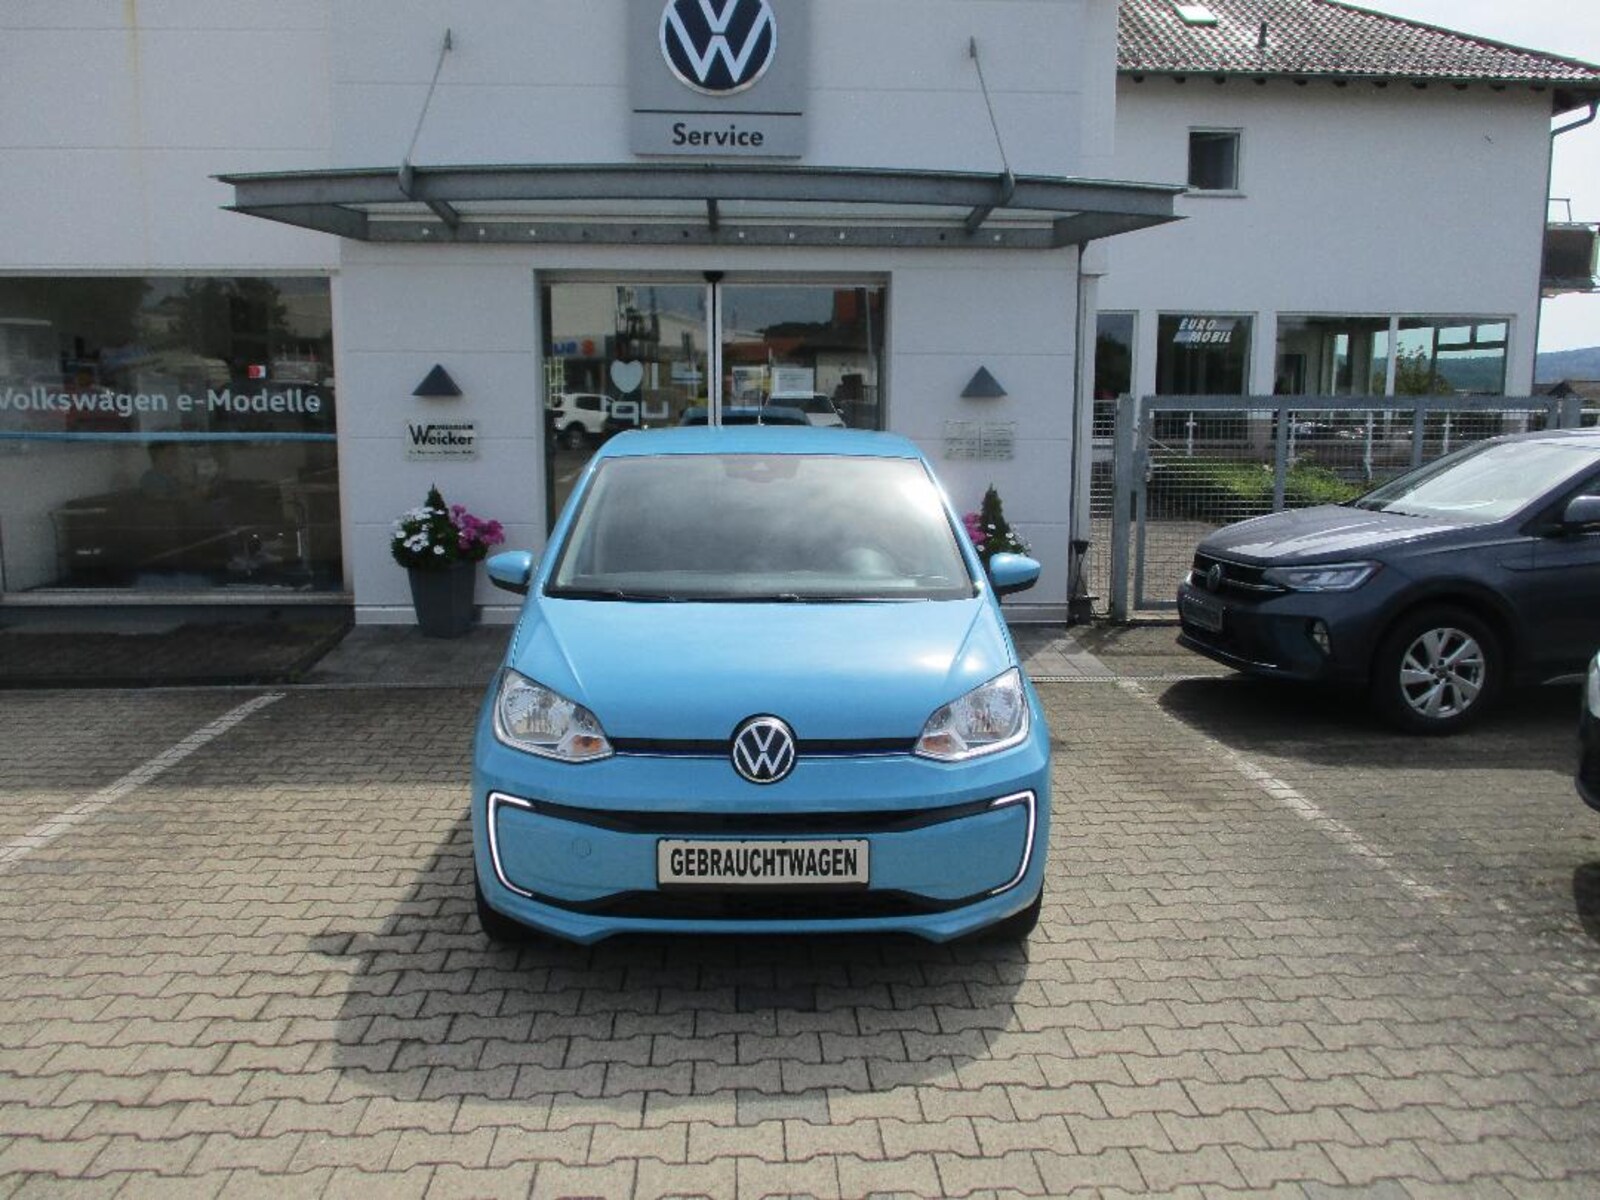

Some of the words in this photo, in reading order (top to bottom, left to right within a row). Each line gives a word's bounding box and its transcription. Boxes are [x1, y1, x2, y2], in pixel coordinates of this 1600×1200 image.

[672, 122, 764, 147] Service
[1179, 318, 1217, 331] EURO
[1190, 331, 1232, 343] MOBIL
[177, 389, 321, 412] e-Modelle
[408, 424, 474, 445] Weicker
[734, 721, 794, 778] VW
[670, 848, 857, 877] GEBRAUCHTWAGEN
